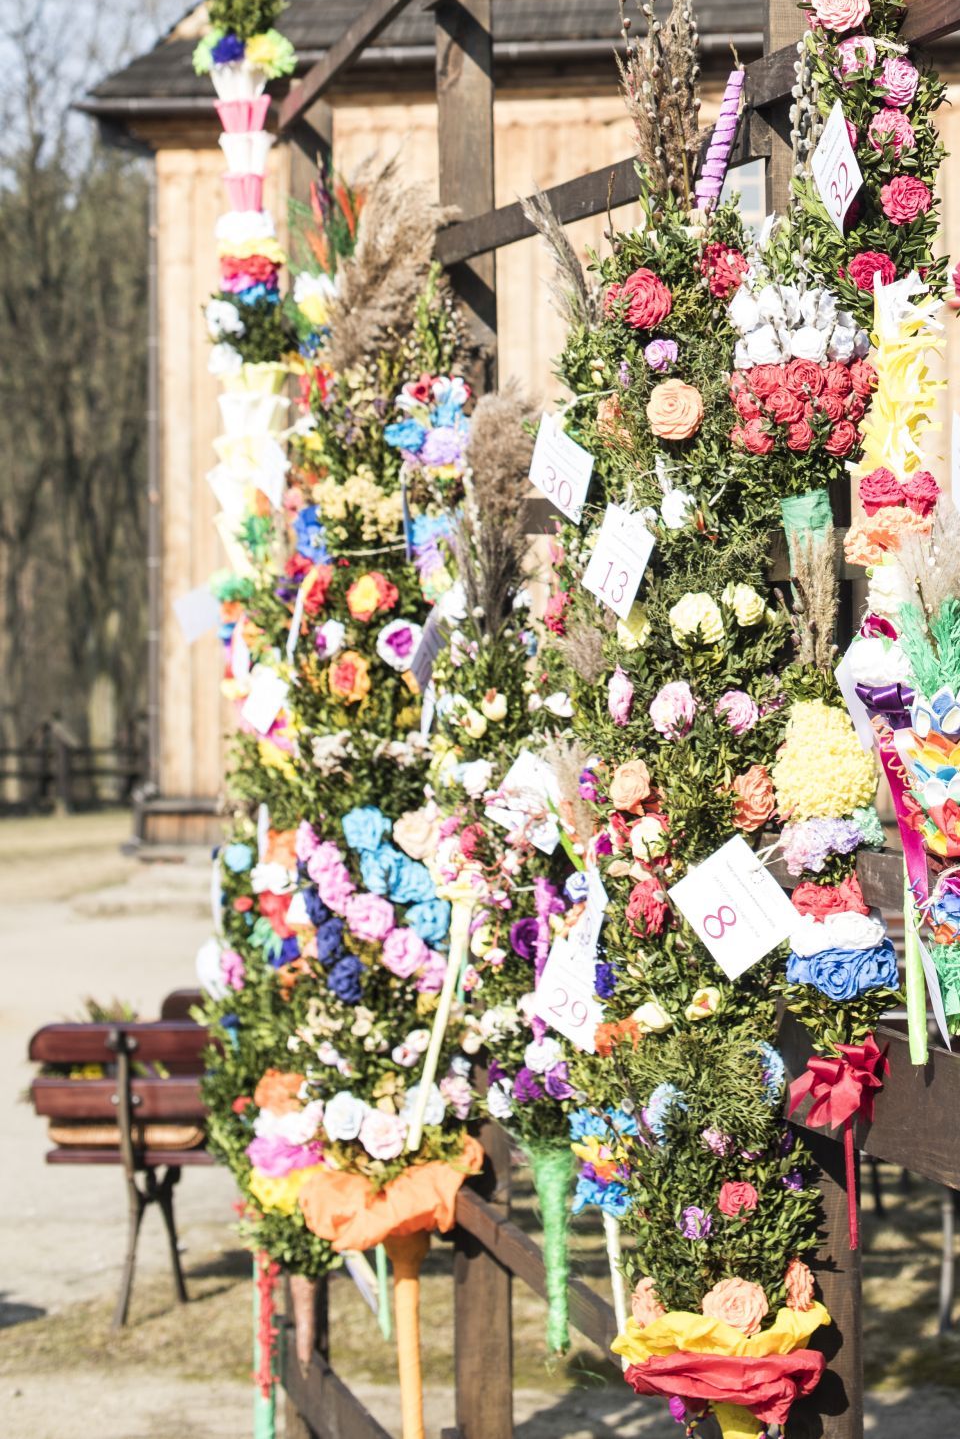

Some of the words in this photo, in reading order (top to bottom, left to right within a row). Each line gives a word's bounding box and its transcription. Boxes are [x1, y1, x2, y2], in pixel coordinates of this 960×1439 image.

[830, 162, 853, 217] 32
[542, 466, 572, 508] 30
[598, 562, 628, 603] 13
[703, 905, 736, 939] 8
[549, 988, 588, 1027] 29
